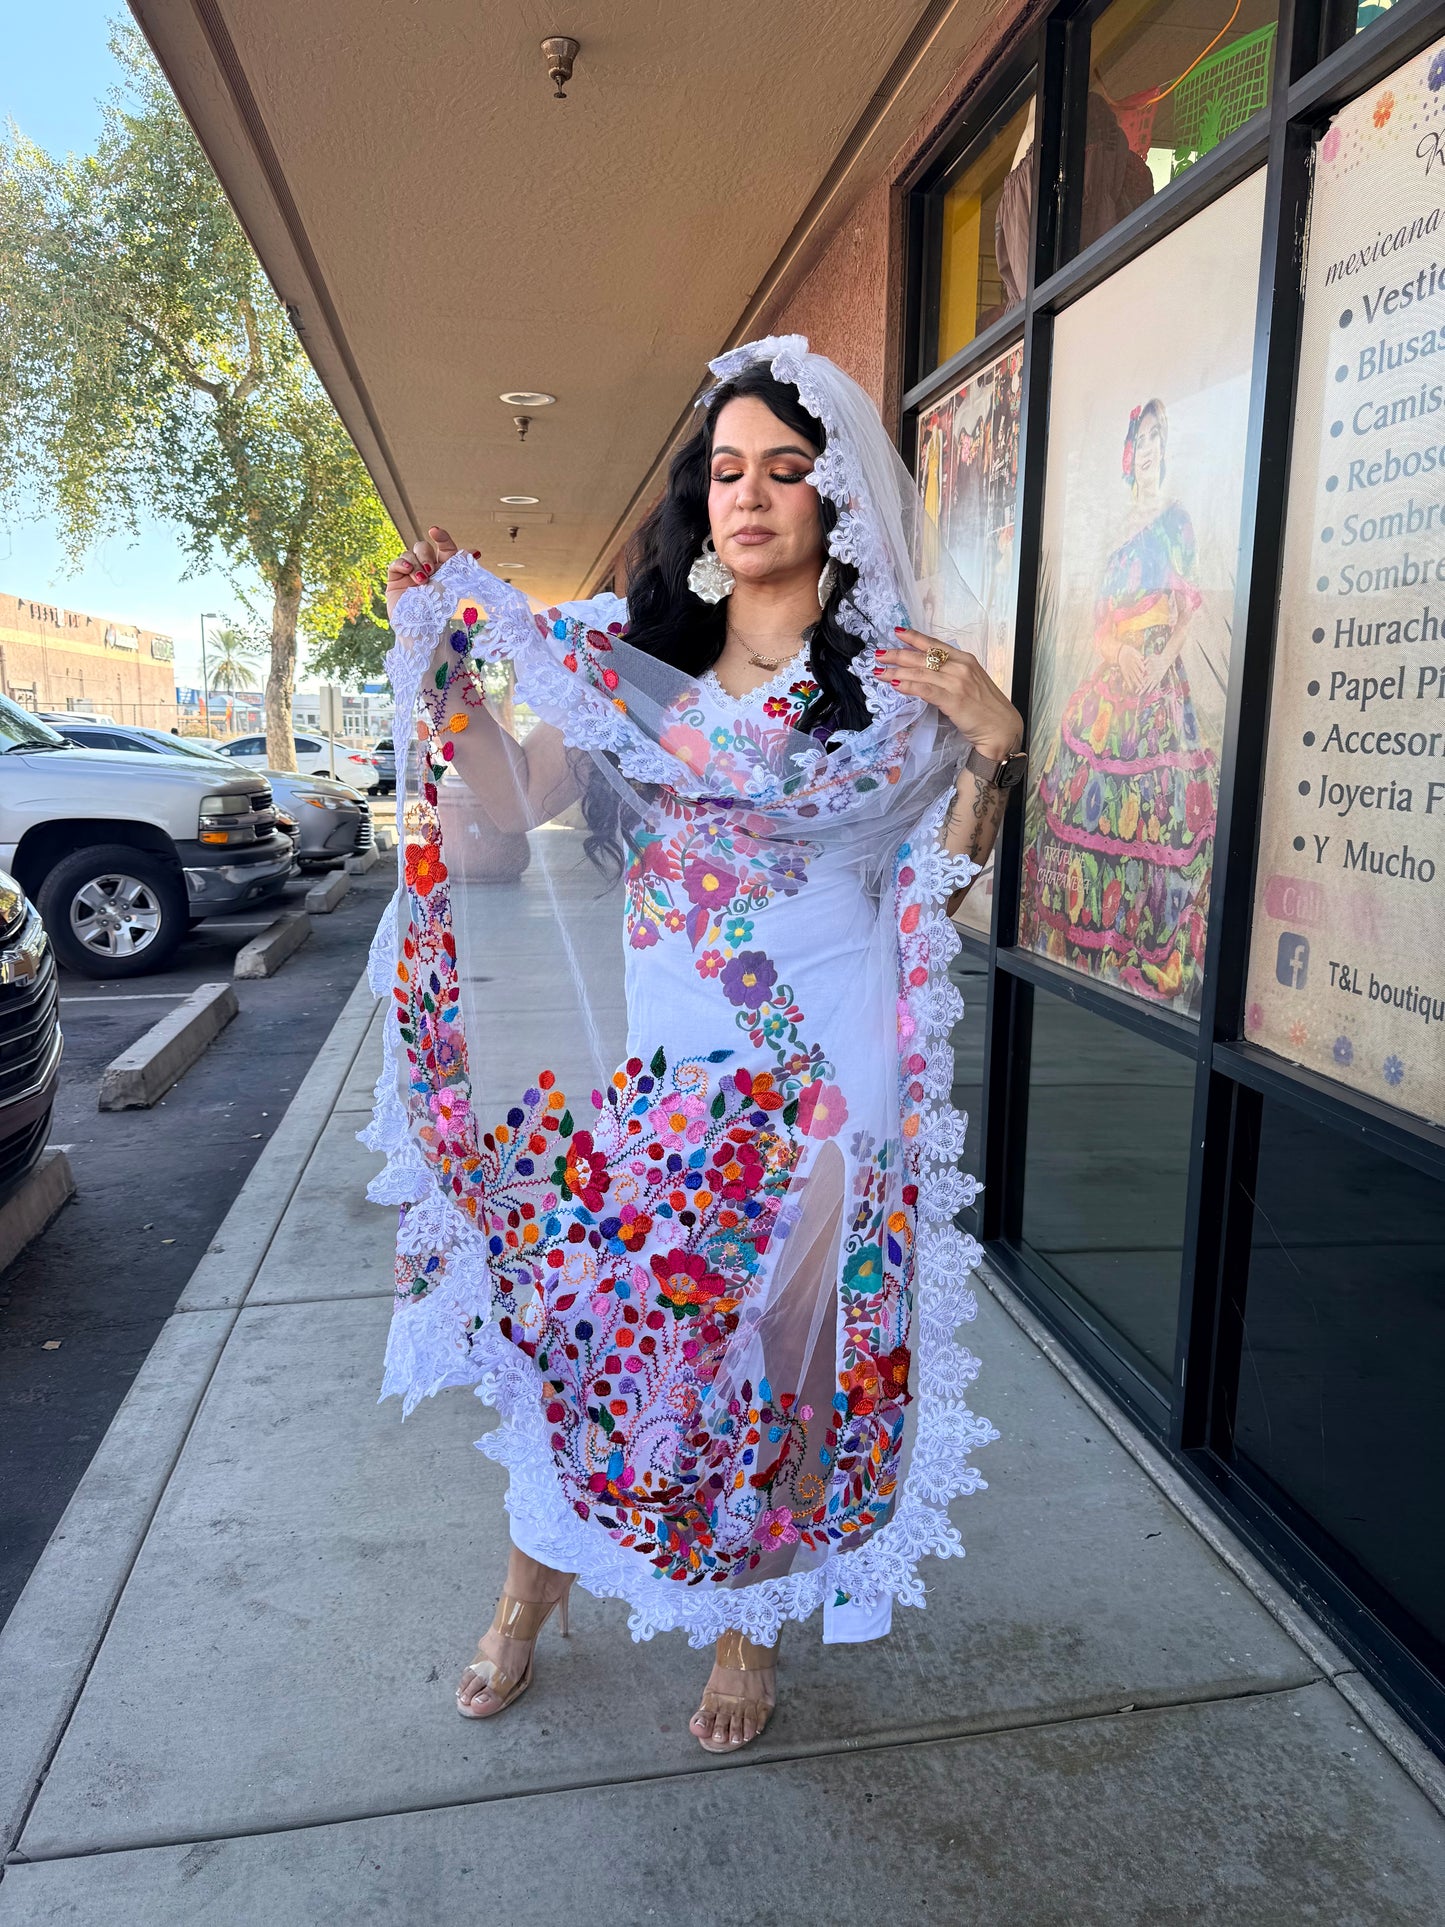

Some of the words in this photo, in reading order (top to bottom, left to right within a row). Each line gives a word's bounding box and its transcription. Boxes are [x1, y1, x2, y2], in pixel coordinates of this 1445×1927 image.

[1352, 383, 1445, 436] Camis
[1329, 665, 1405, 712] Papel
[1318, 774, 1412, 817] Joyeria
[1425, 781, 1445, 815] F
[1313, 834, 1330, 864] Y
[1328, 960, 1363, 996] T&L
[1368, 972, 1445, 1024] boutiqu
